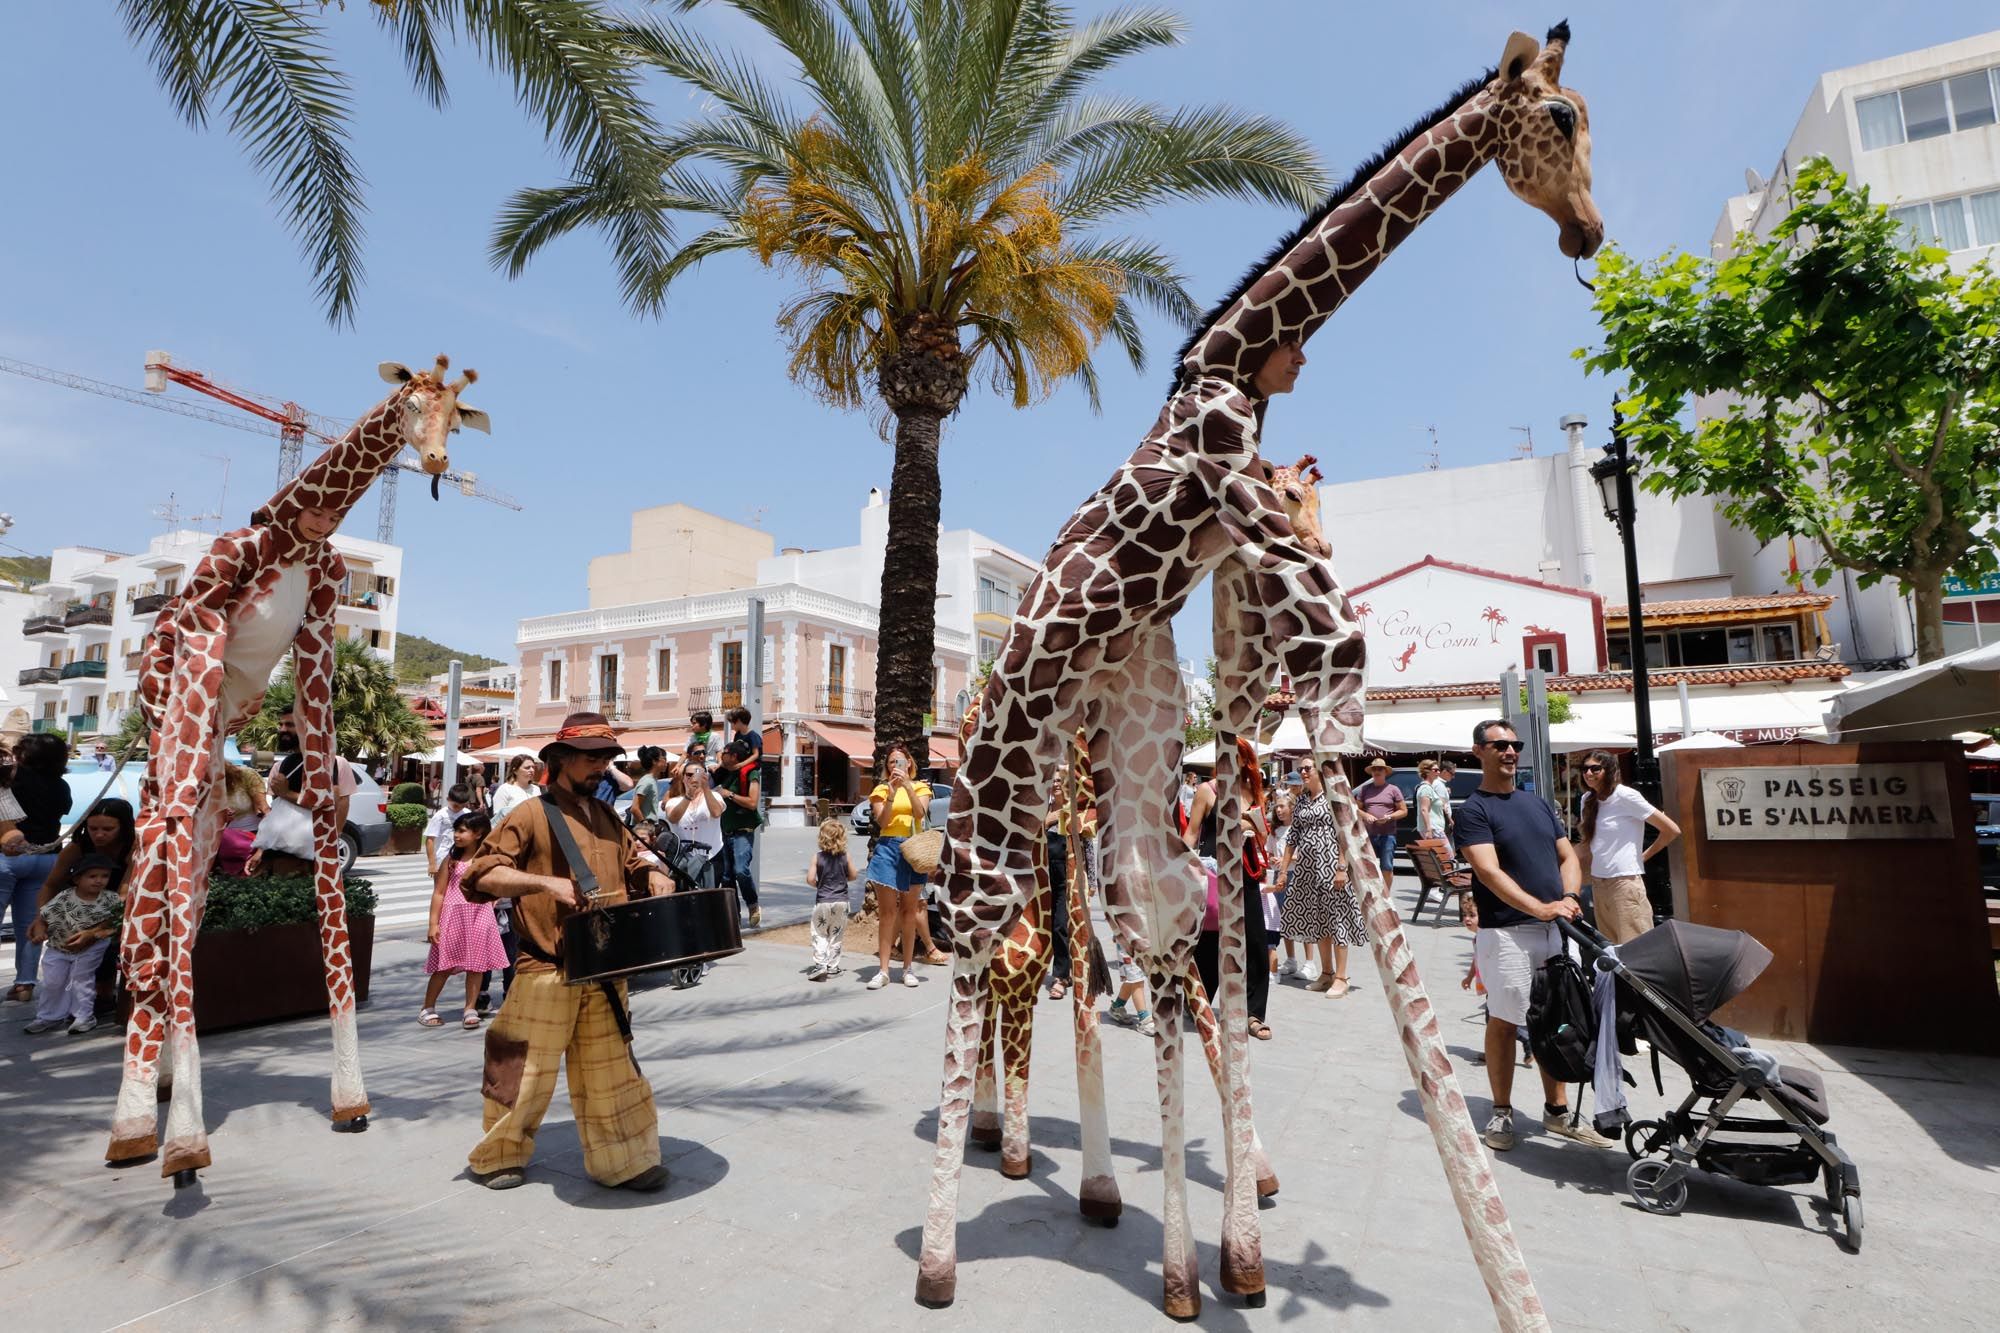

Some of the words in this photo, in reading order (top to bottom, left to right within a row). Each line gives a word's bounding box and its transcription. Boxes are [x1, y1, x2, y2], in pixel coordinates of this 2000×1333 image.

[1943, 581, 1964, 592] Tel.
[1425, 622, 1480, 649] Cosmi
[1765, 776, 1908, 798] PASSEIG
[1716, 808, 1753, 826] DE
[1765, 804, 1938, 826] S'ALAMERA
